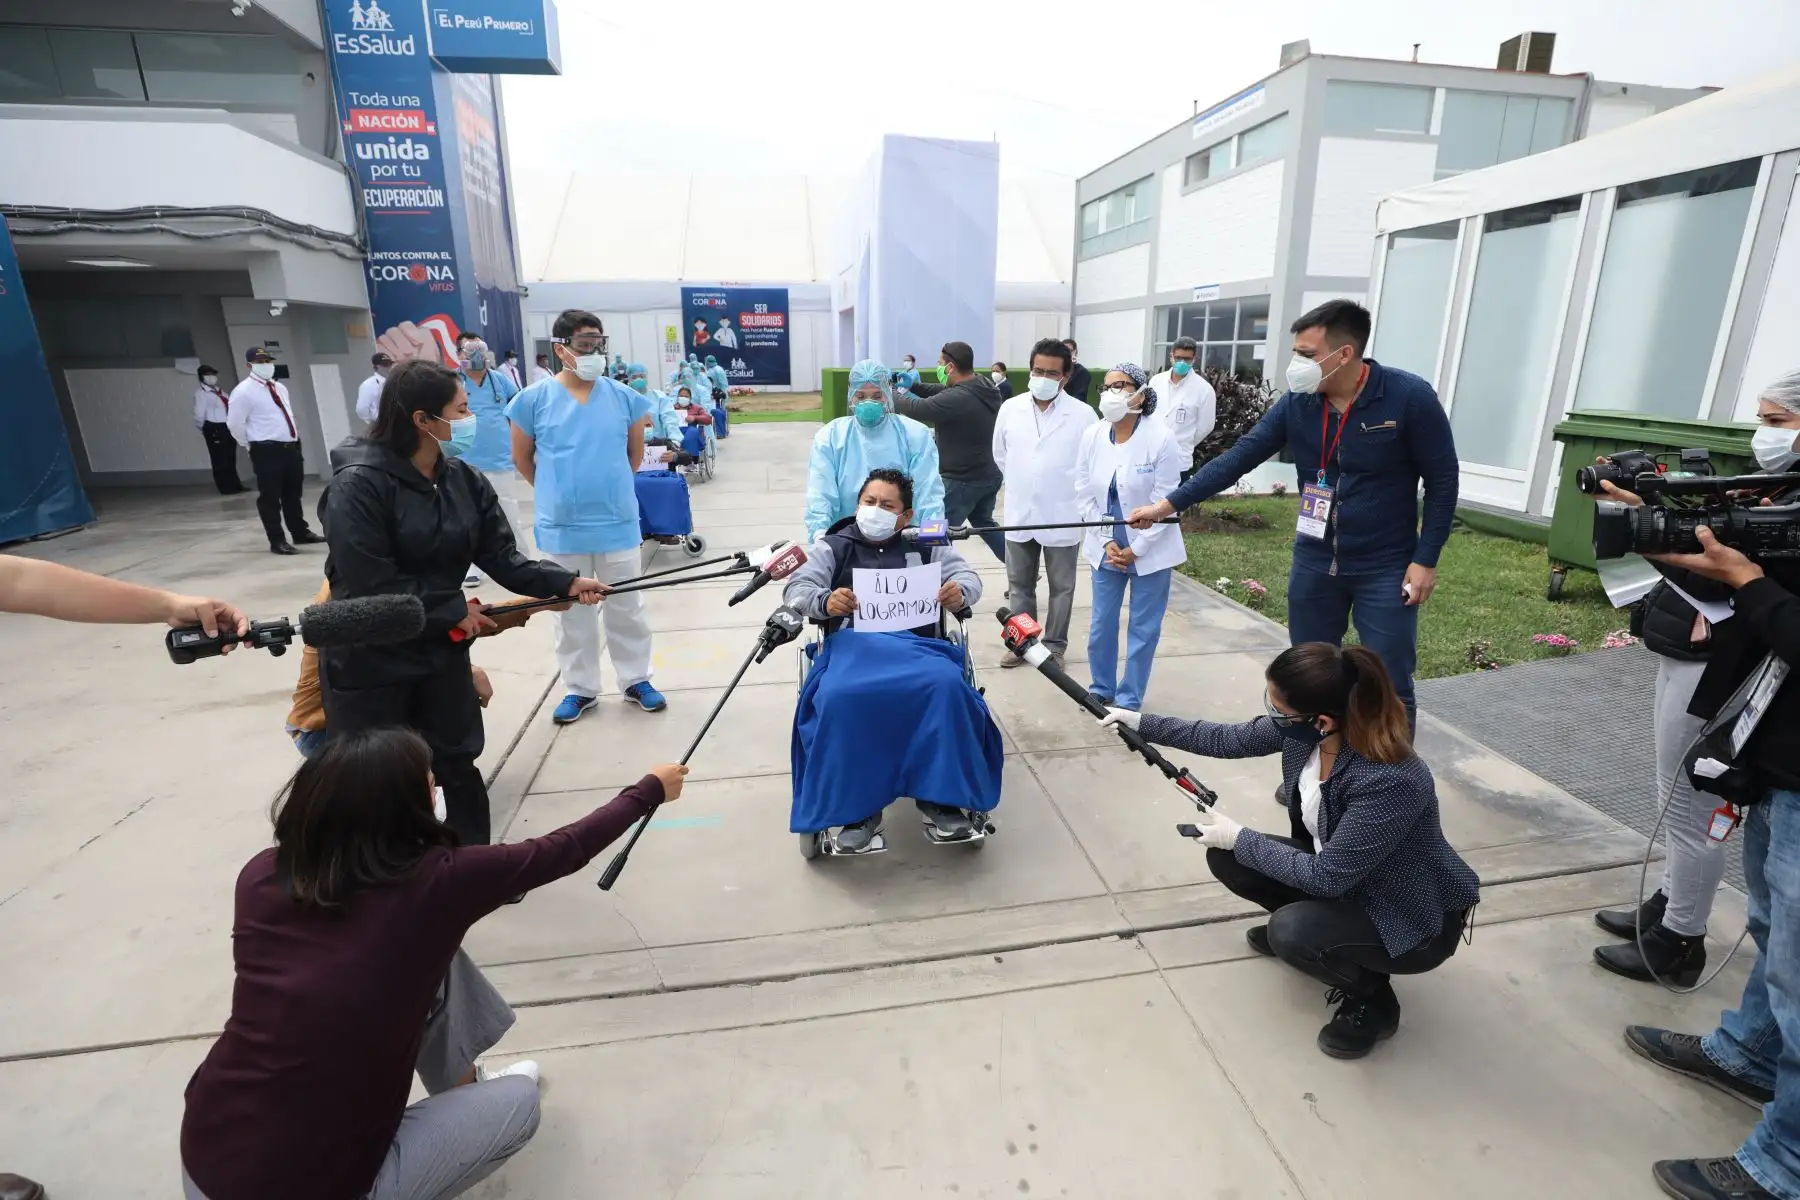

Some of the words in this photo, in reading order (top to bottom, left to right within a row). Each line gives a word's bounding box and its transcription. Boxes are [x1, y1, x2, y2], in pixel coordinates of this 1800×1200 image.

[334, 33, 415, 56] EsSalud
[349, 92, 388, 107] Toda
[392, 94, 420, 107] una
[358, 113, 419, 129] NACIÓN
[356, 136, 429, 160] unida
[370, 164, 398, 182] por
[401, 163, 421, 177] tu
[364, 186, 444, 208] ECUPERACIÓN
[402, 251, 439, 260] CONTRA
[441, 251, 452, 260] EL
[369, 264, 455, 283] CORONA
[429, 281, 455, 293] virus
[754, 303, 768, 314] SER
[741, 315, 782, 326] SOLIDARIOS
[725, 369, 754, 378] EsSalud
